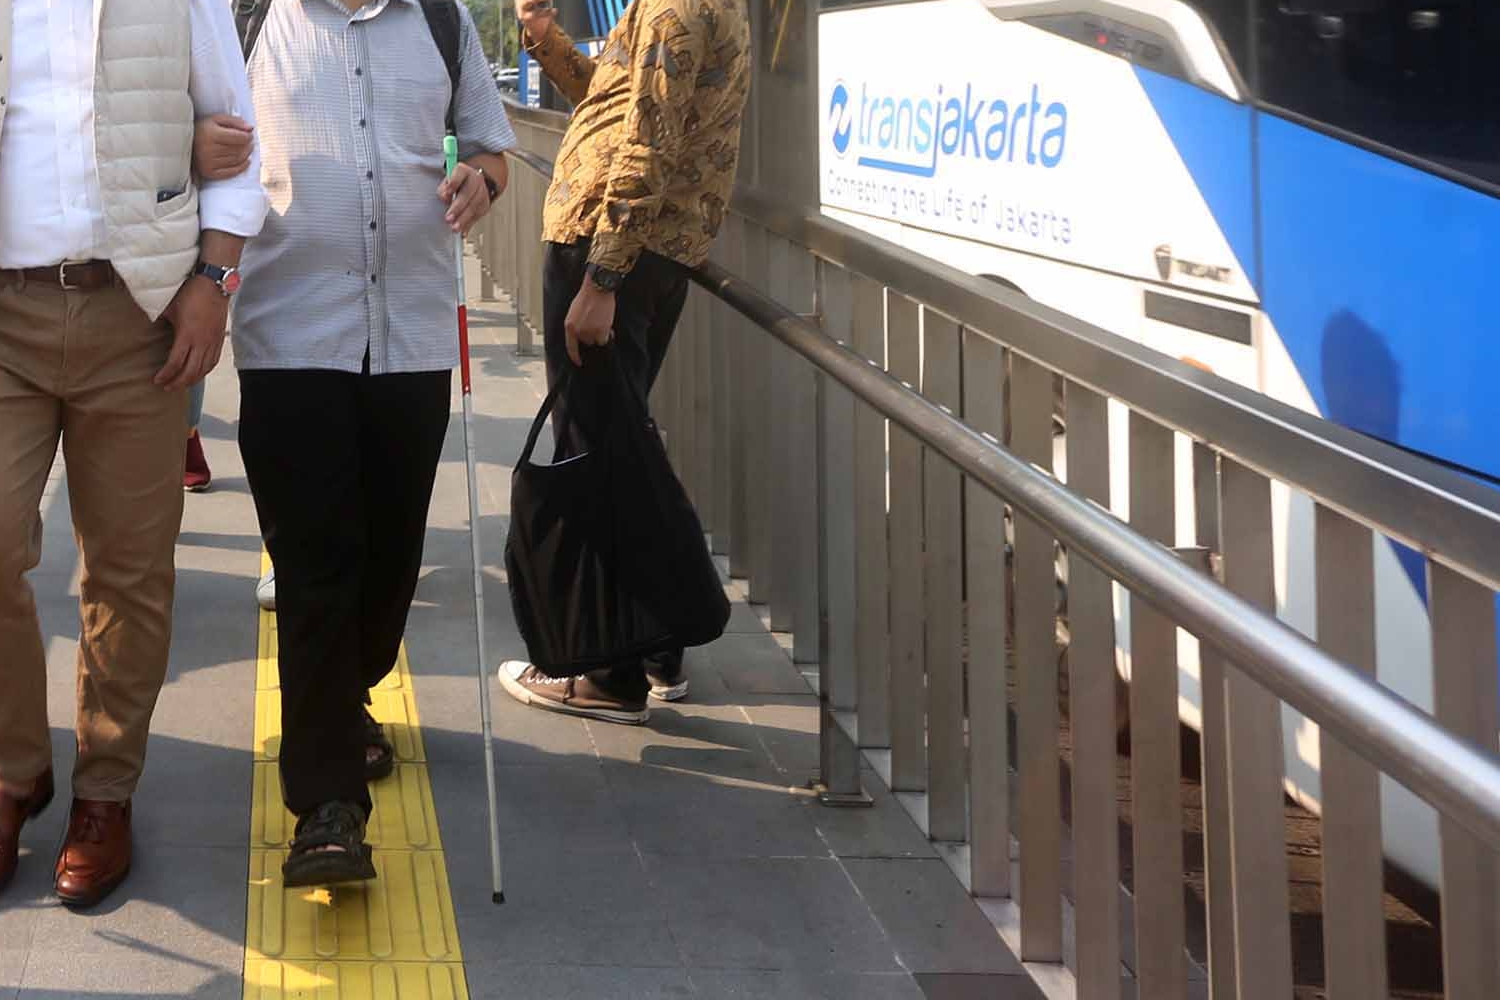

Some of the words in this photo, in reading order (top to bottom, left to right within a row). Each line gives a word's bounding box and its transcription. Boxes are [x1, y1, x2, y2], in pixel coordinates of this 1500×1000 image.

[857, 82, 1068, 177] transjakarta
[825, 168, 898, 215] Connecting
[903, 186, 926, 214] the
[933, 187, 963, 222] Life
[971, 193, 988, 224] of
[995, 198, 1072, 244] Jakarta
